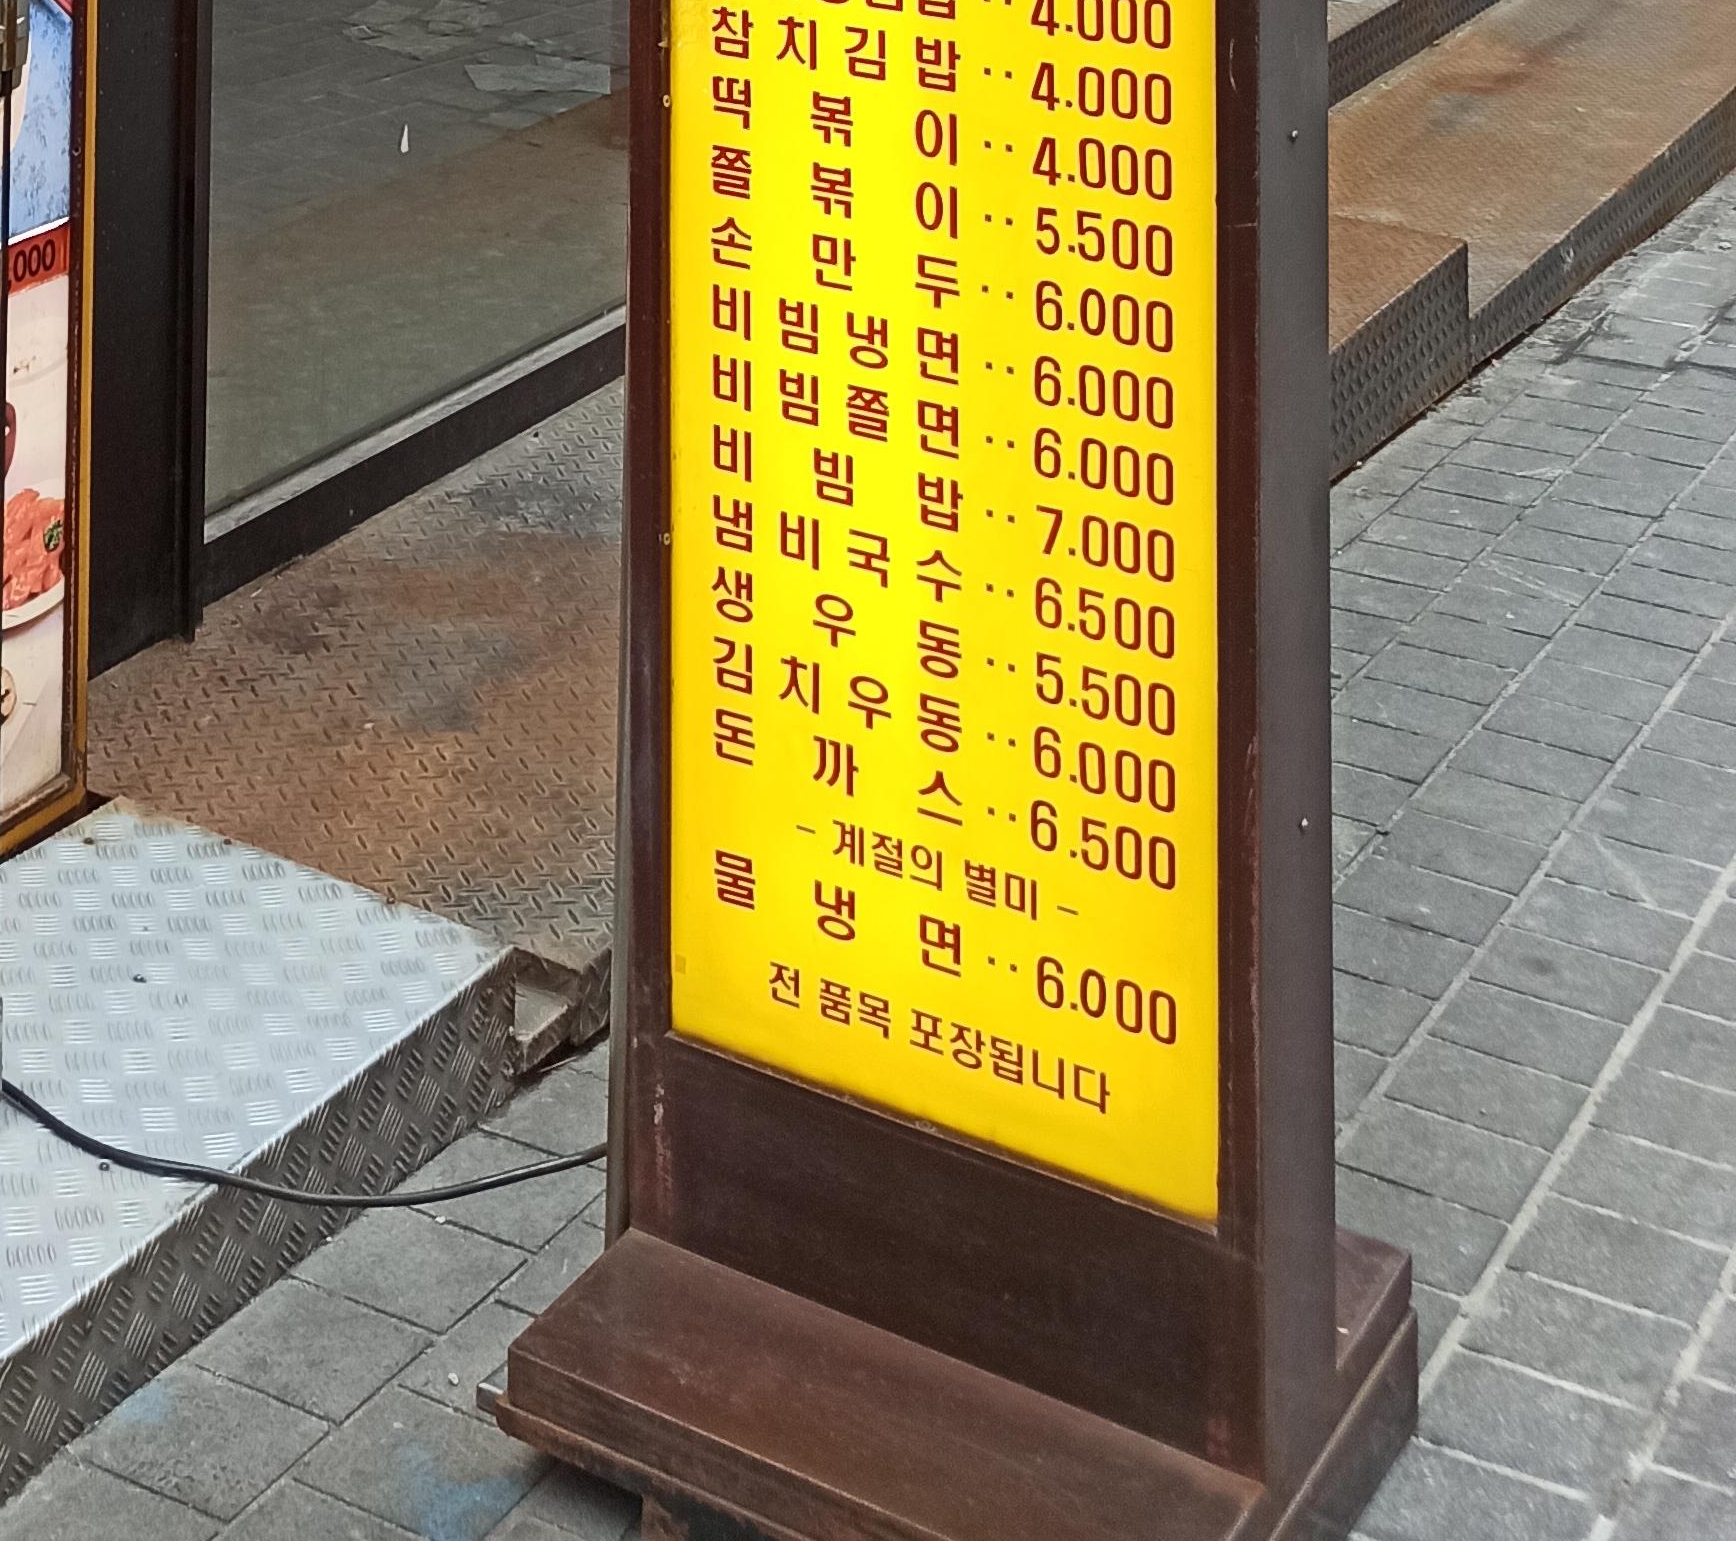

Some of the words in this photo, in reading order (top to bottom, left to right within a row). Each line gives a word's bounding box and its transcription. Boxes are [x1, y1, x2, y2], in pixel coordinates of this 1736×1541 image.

[1030, 61, 1173, 125] 4.000
[1032, 135, 1173, 202] 4.000
[1035, 207, 1173, 278] 5.500
[1034, 280, 1174, 354] 6.000
[1033, 355, 1175, 430] 6.000
[1033, 427, 1175, 506] 6.000
[1035, 505, 1175, 584] 7.000
[1033, 577, 1175, 660] 6.500
[1035, 652, 1176, 736] 5.500
[1033, 726, 1177, 814] 6.000
[831, 819, 944, 890] 계절의
[963, 859, 1039, 920] 별미
[1030, 798, 1177, 891] 6.500
[1035, 955, 1177, 1046] 6.000
[818, 976, 892, 1039] 품목
[909, 1008, 1112, 1115] 포장됩니다
